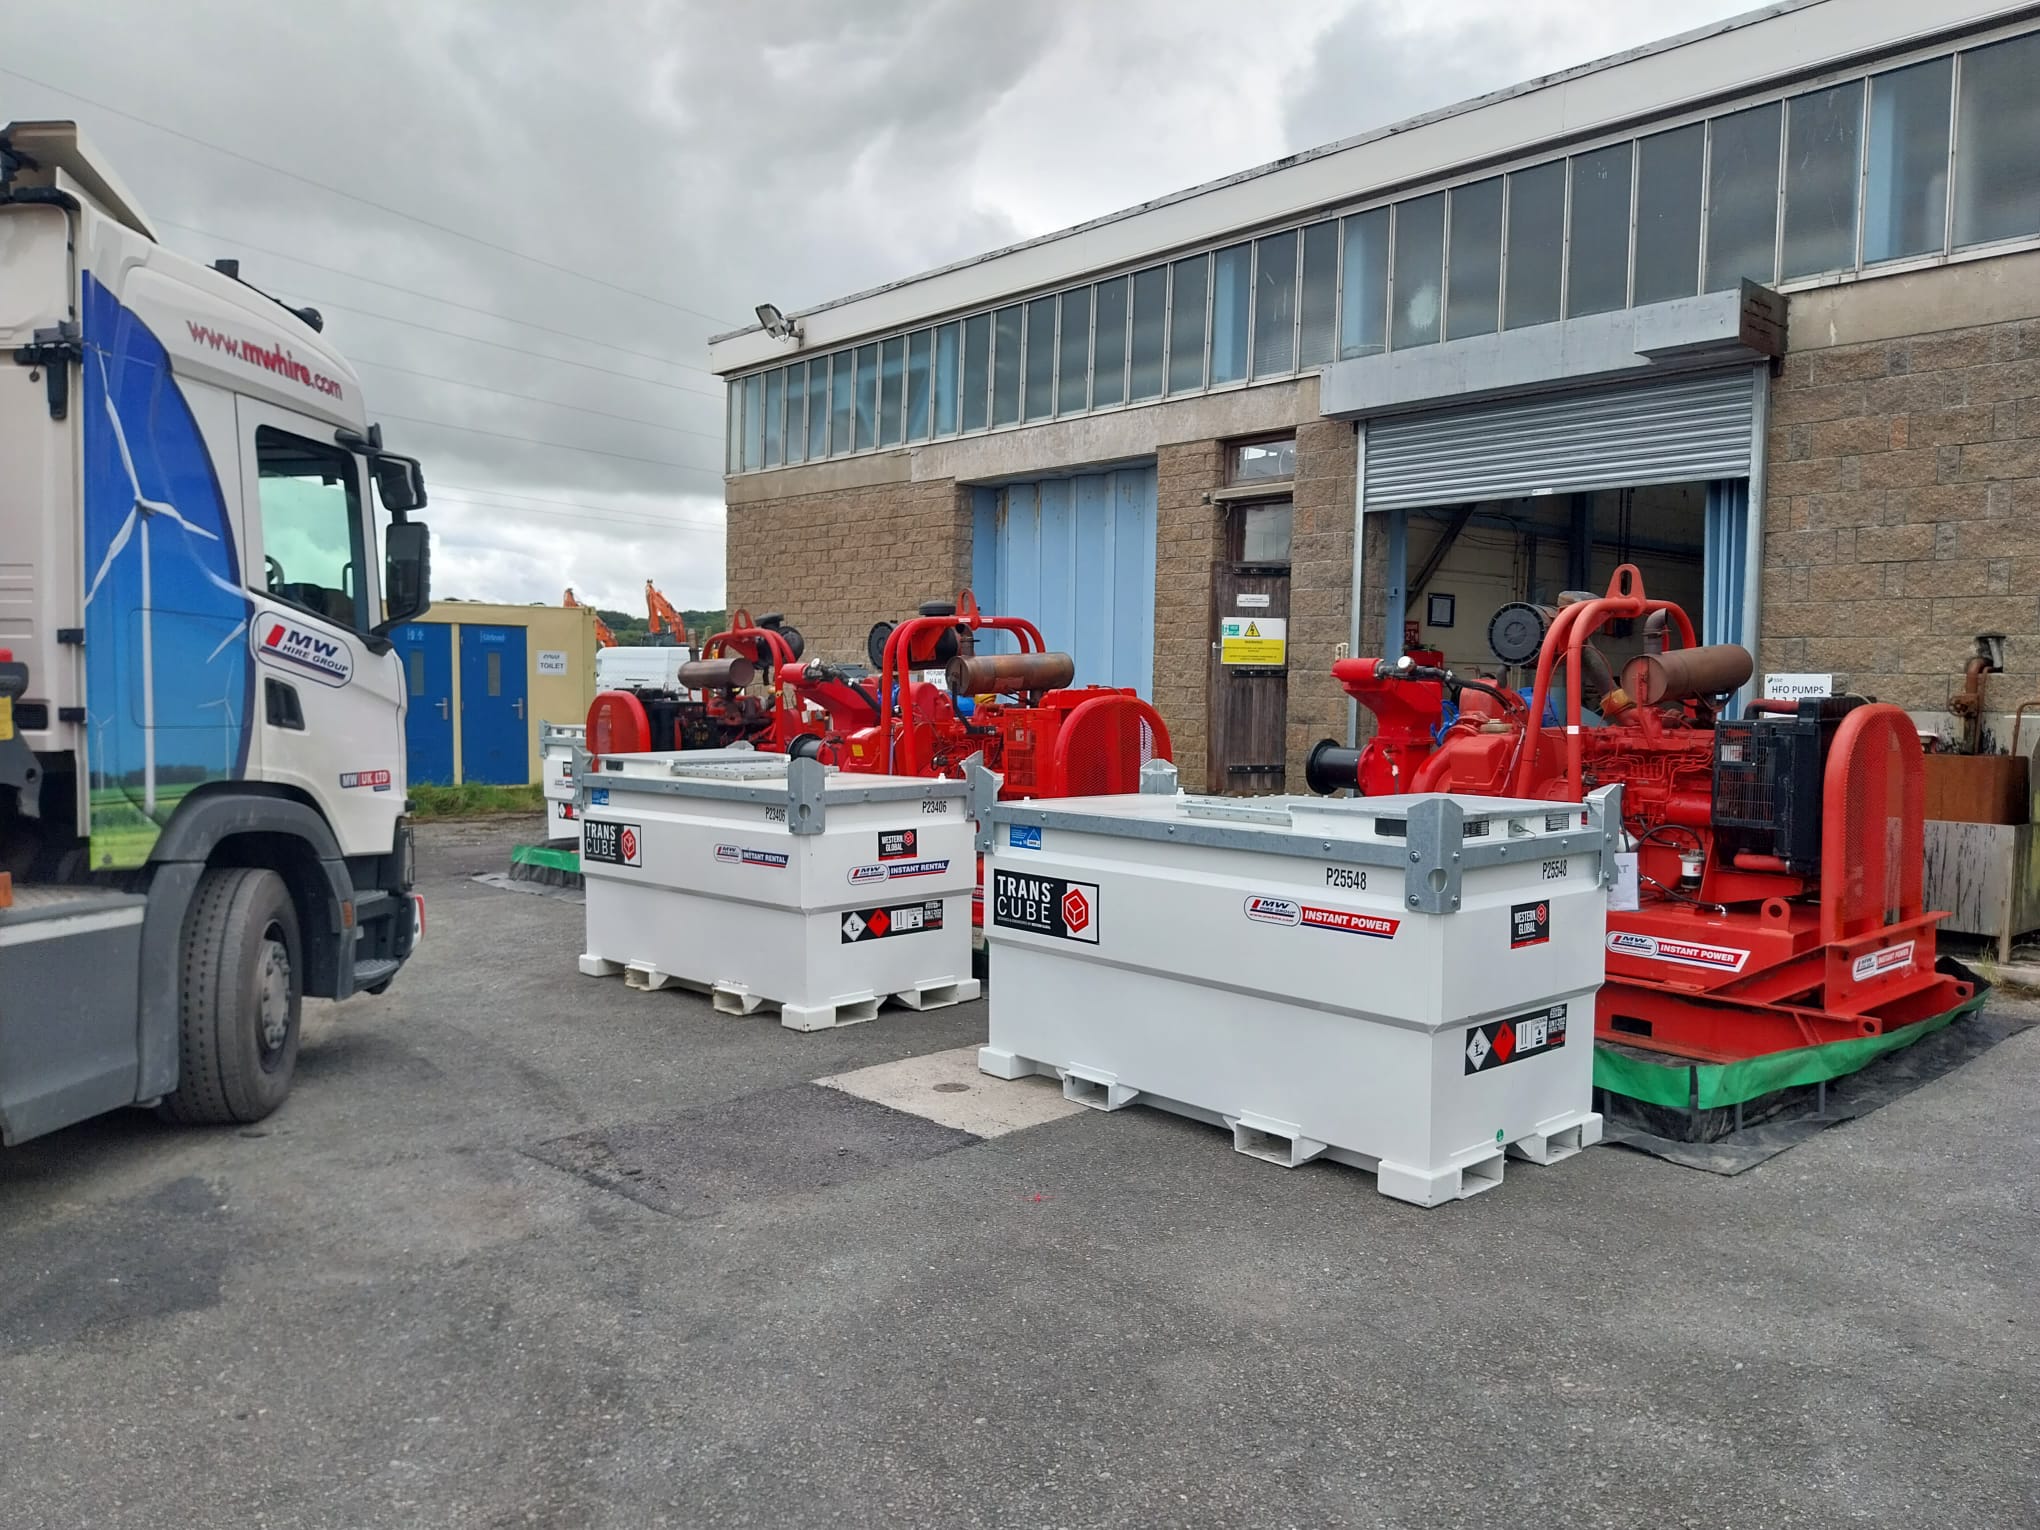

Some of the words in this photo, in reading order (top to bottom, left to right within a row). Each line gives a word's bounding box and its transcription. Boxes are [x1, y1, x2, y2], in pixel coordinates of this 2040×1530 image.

[186, 320, 343, 400] www.mwhire.com
[287, 630, 338, 657] MW
[282, 644, 310, 659] HIRE
[313, 655, 348, 672] GROUP
[1772, 685, 1790, 694] HFO
[1792, 685, 1824, 694] PUMPS
[765, 806, 786, 822] P23406
[922, 800, 947, 814] P23406
[585, 823, 616, 840] TRANS
[585, 838, 616, 856] CUBE
[890, 864, 919, 874] INSTANT
[920, 862, 946, 871] RENTAL
[1326, 867, 1367, 890] P25548
[1543, 859, 1568, 880] P25548
[997, 875, 1051, 903] TRANS
[997, 896, 1051, 924] CUBE
[1261, 900, 1290, 909] MW
[1304, 910, 1349, 925] INSTANT
[1350, 916, 1391, 932] POWER
[1622, 935, 1647, 943] MW
[1660, 943, 1699, 957] INSTANT
[1700, 949, 1734, 962] POWER
